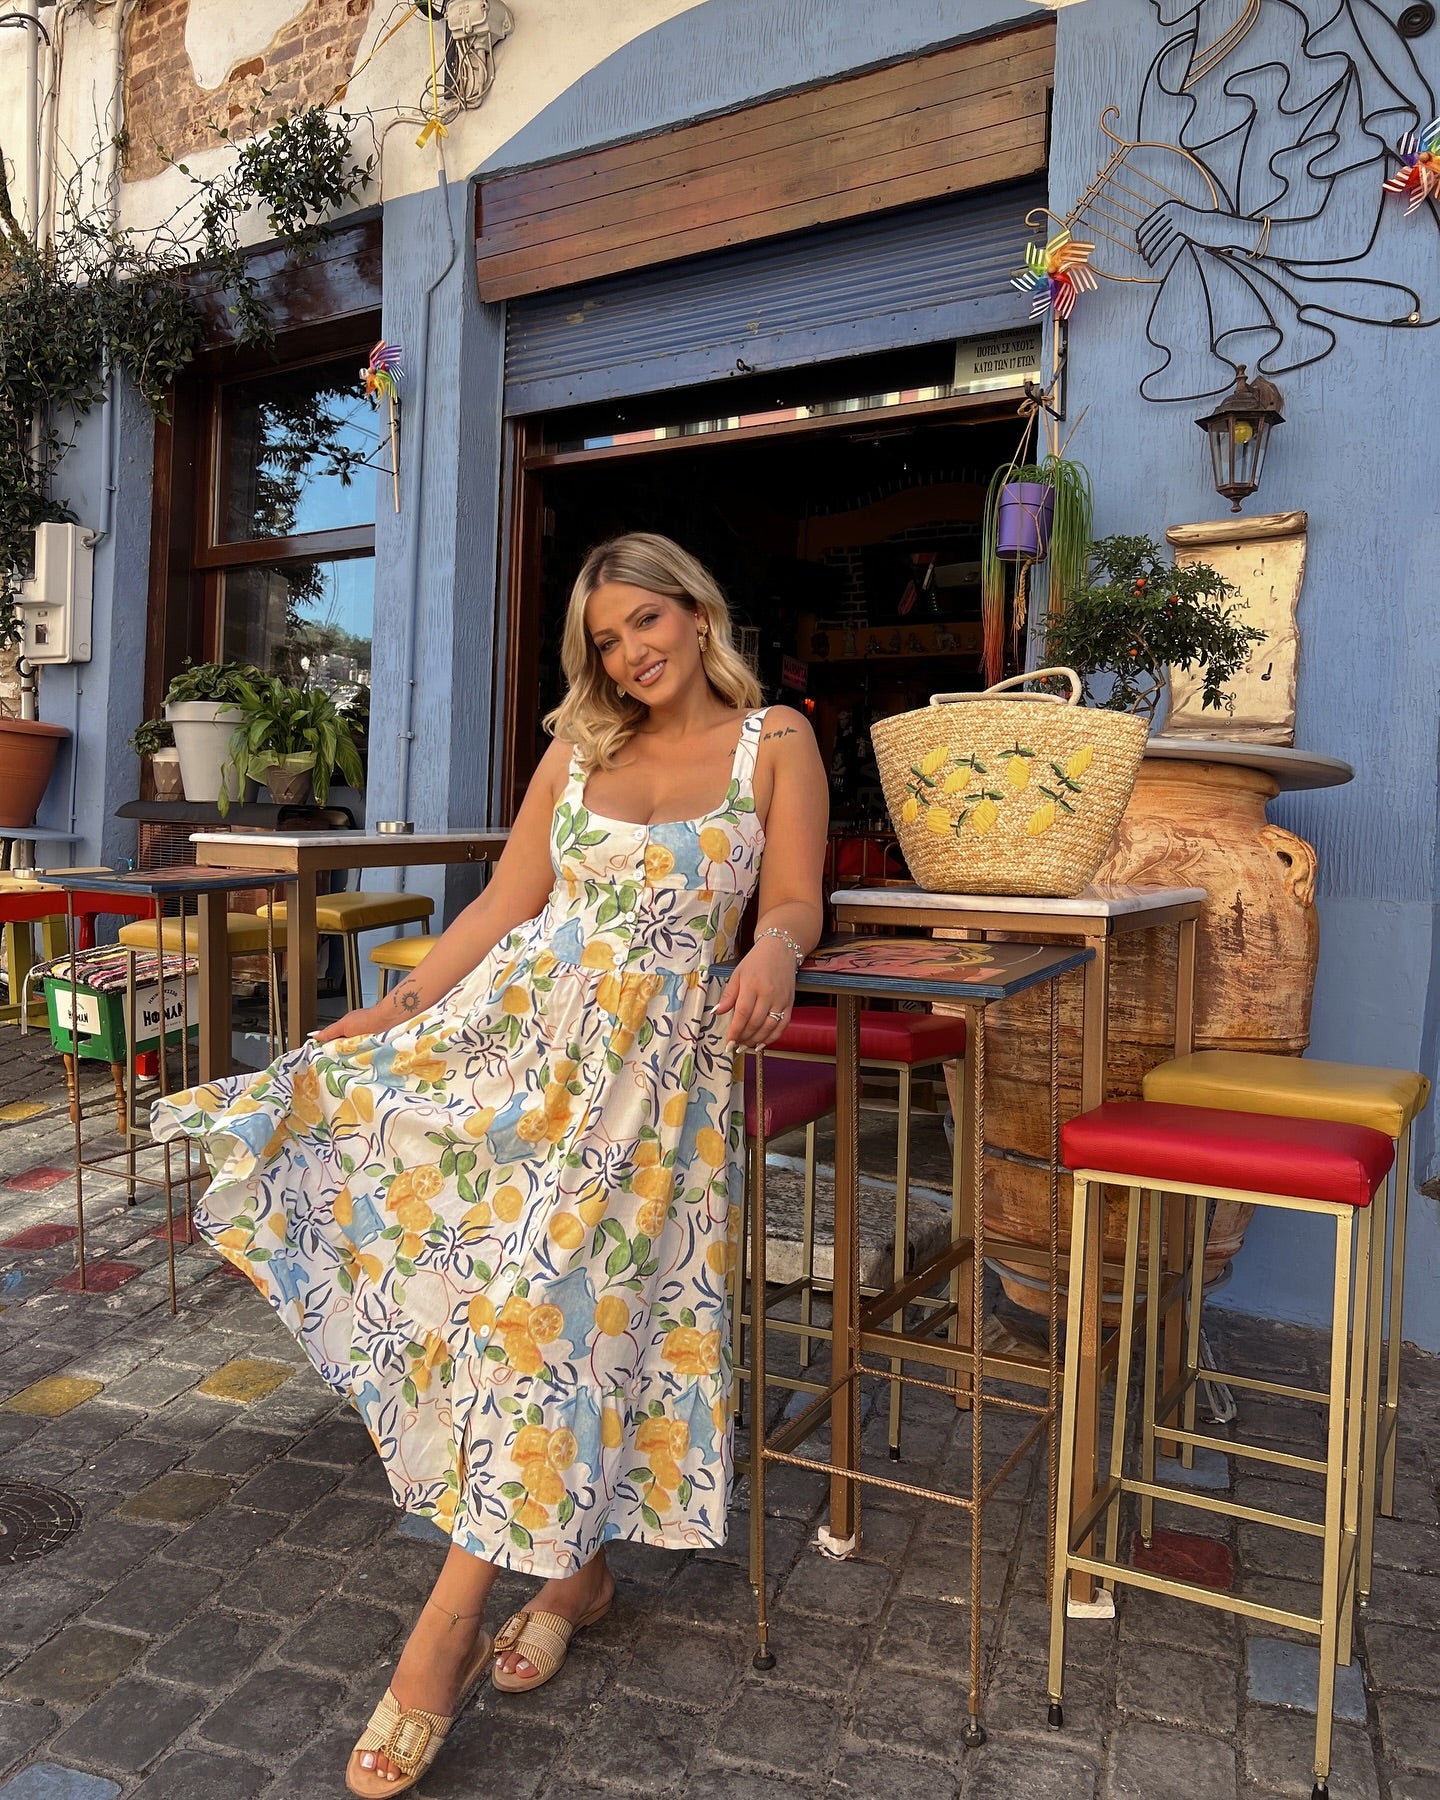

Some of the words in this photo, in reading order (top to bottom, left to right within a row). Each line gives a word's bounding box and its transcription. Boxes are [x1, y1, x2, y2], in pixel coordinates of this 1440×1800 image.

[976, 344, 1001, 358] ΠΟΤΩΝ
[1001, 342, 1011, 354] ΣΕ
[1011, 338, 1035, 353] ΝΕΟΥΣ
[973, 360, 993, 374] ΚΑΤΩ
[993, 359, 1009, 371] ΤΩΝ
[1009, 357, 1016, 369] 17
[1016, 354, 1036, 368] ΕΤΩΝ
